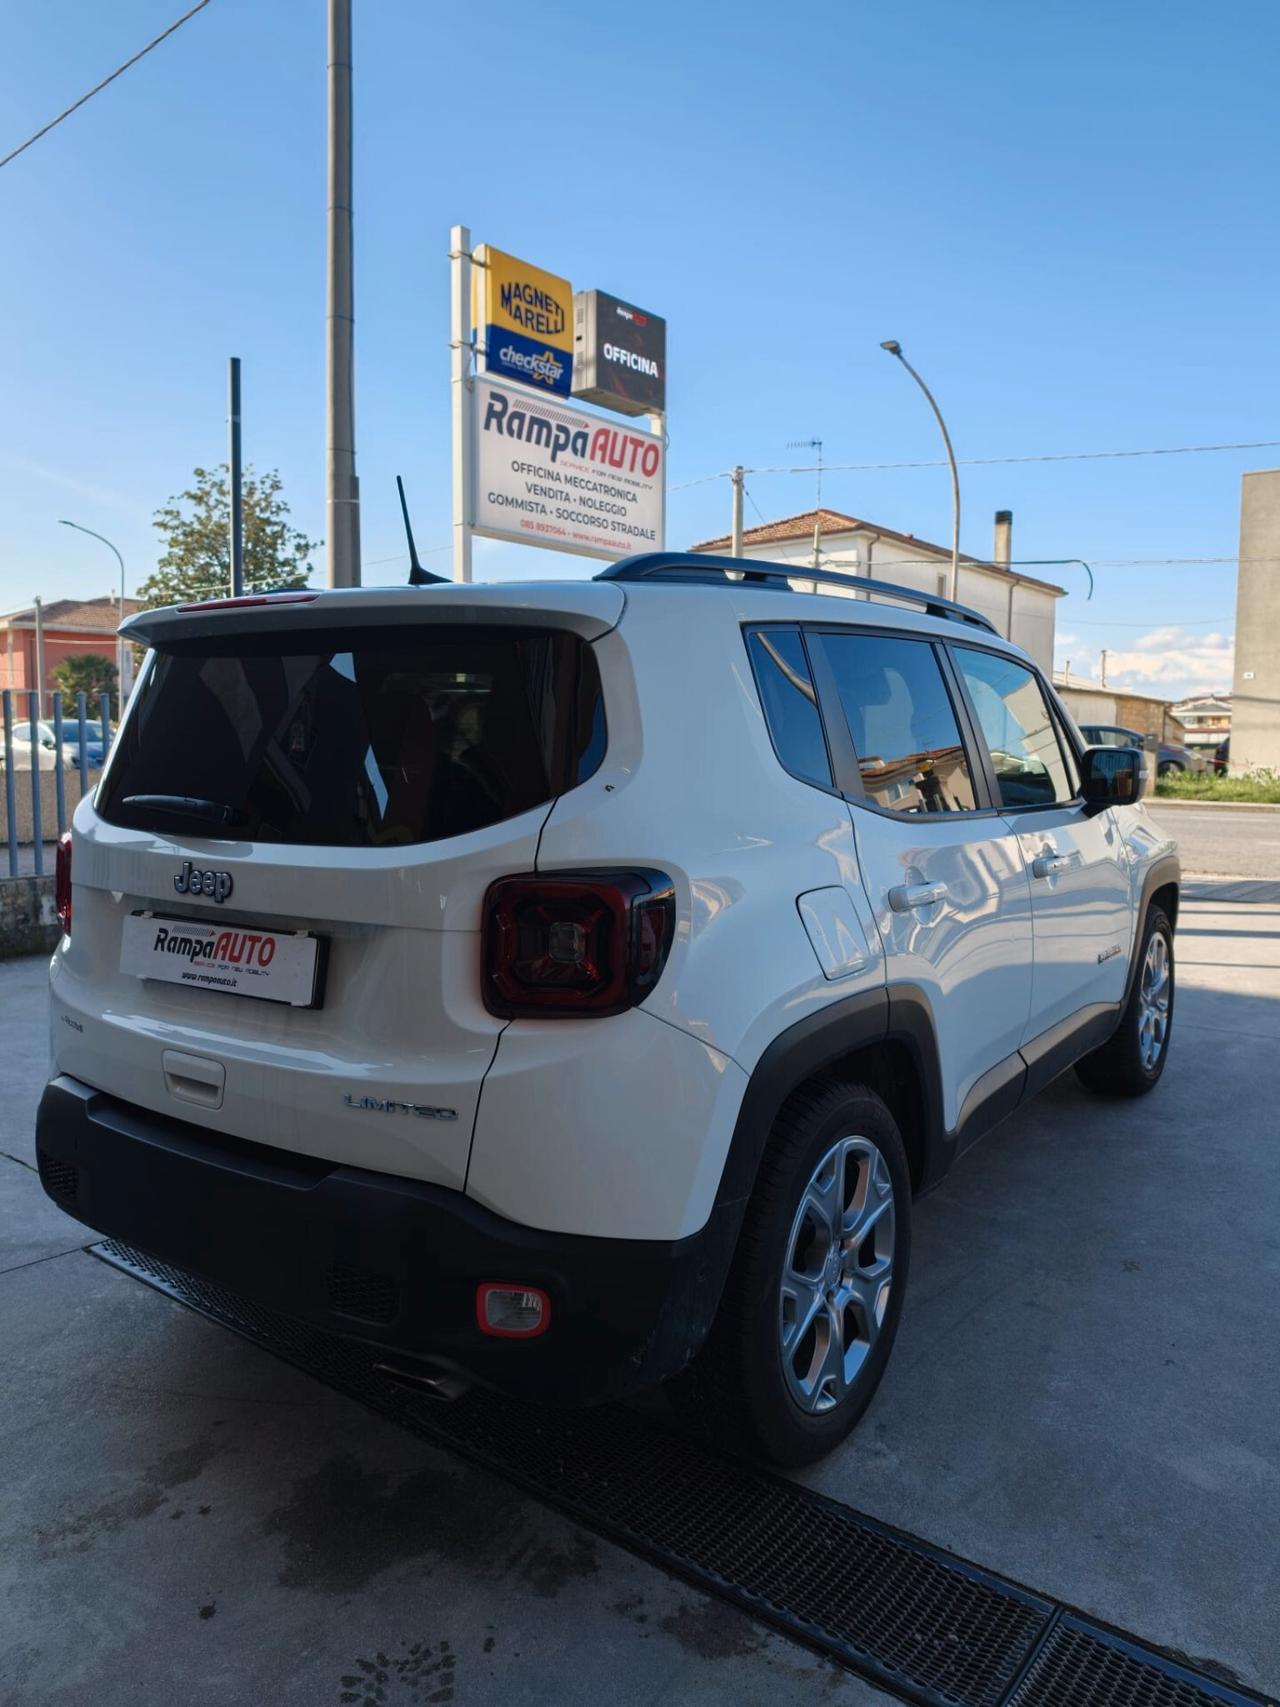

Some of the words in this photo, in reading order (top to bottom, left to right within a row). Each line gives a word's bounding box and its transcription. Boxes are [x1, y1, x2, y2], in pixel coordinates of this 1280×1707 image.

[499, 345, 564, 380] checkstar
[603, 343, 659, 378] OFFICINA
[511, 460, 562, 484] OFFICINA
[564, 475, 638, 504] MECCATRONICA
[525, 481, 571, 504] VENDITA
[579, 495, 627, 517] NOLEGGIO
[487, 491, 548, 515] GOMMISTA
[555, 507, 608, 530] SOCCORSO
[611, 522, 656, 541] STRADALE
[174, 861, 233, 904] Jeep
[344, 1094, 459, 1121] LIMITED
